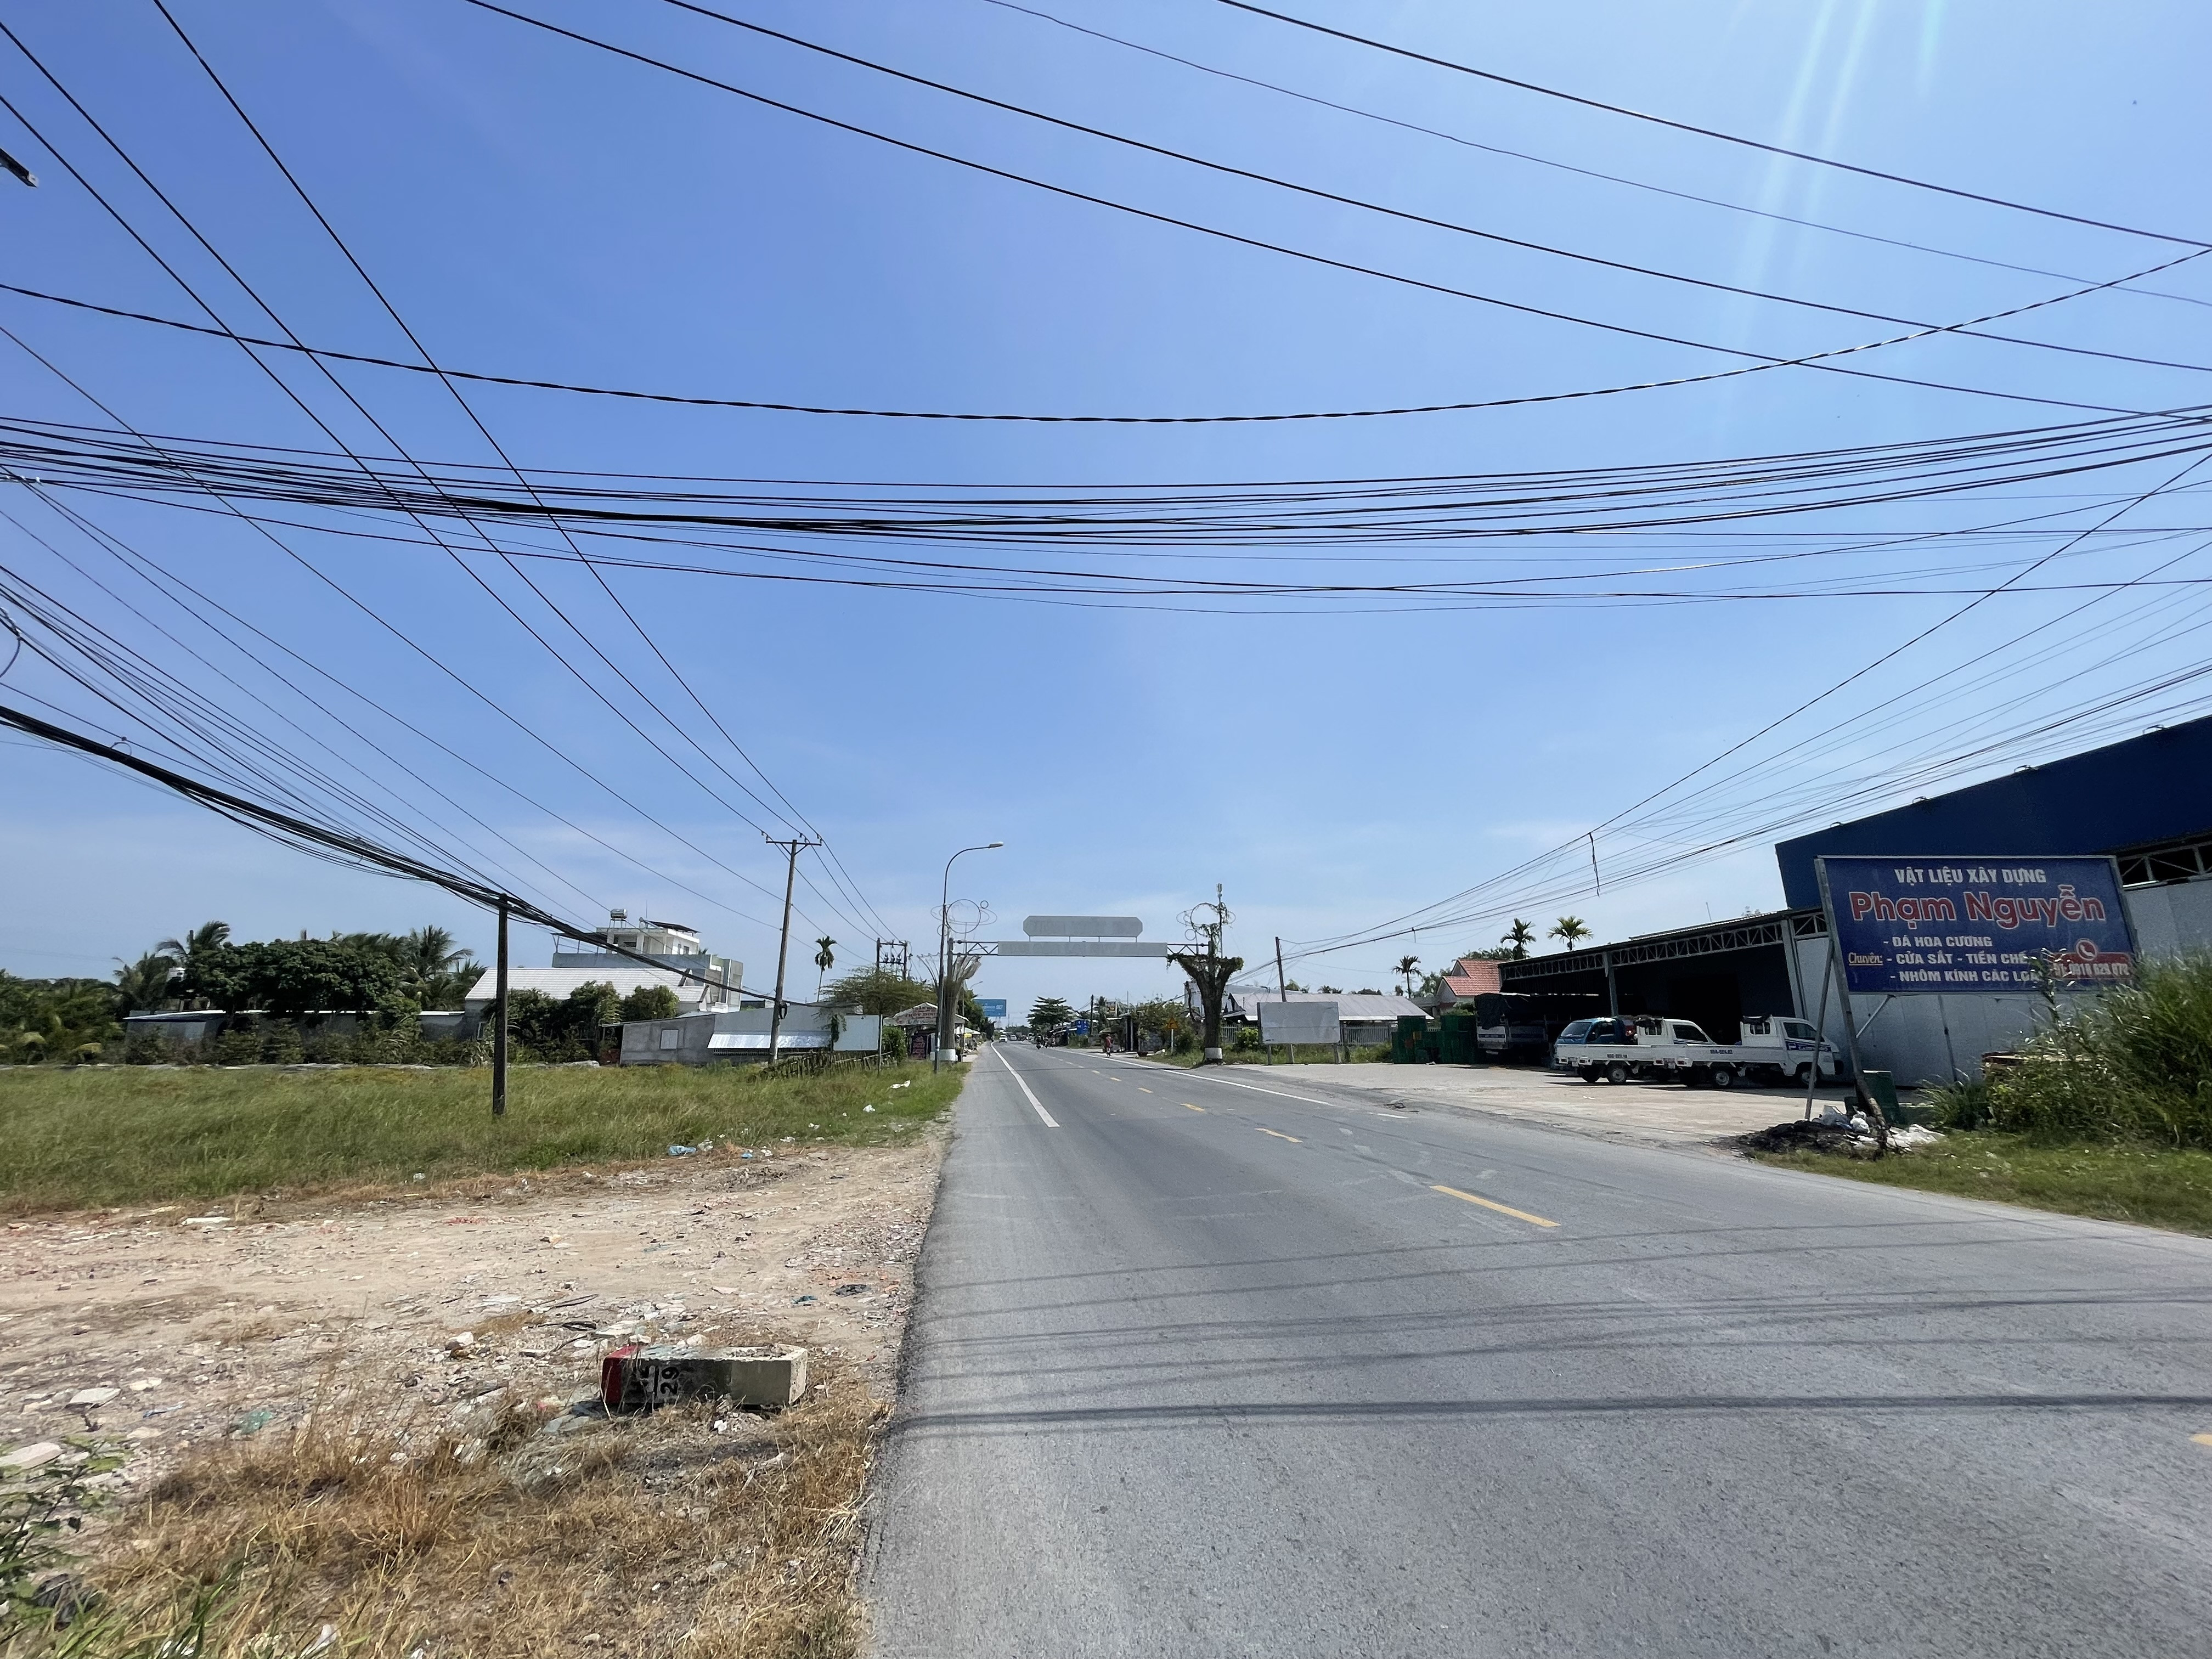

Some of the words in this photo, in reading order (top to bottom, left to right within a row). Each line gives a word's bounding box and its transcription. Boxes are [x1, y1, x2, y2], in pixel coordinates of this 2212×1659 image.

[1894, 866, 1923, 885] VẬT
[1928, 866, 1963, 885] LIỆU
[1966, 866, 1997, 883] XÂY
[2001, 868, 2046, 886] DỰNG
[1848, 891, 1957, 930] Phạm
[1963, 884, 2107, 930] Nguyễn
[1892, 934, 1911, 947] ĐÁ
[1914, 936, 1943, 947] HOA
[1945, 935, 1993, 947] CƯƠNG
[1896, 950, 1924, 964] CỬA
[1899, 969, 1942, 981] NHÔM
[1944, 968, 1979, 981] KÍNH
[660, 1367, 679, 1395] 29
